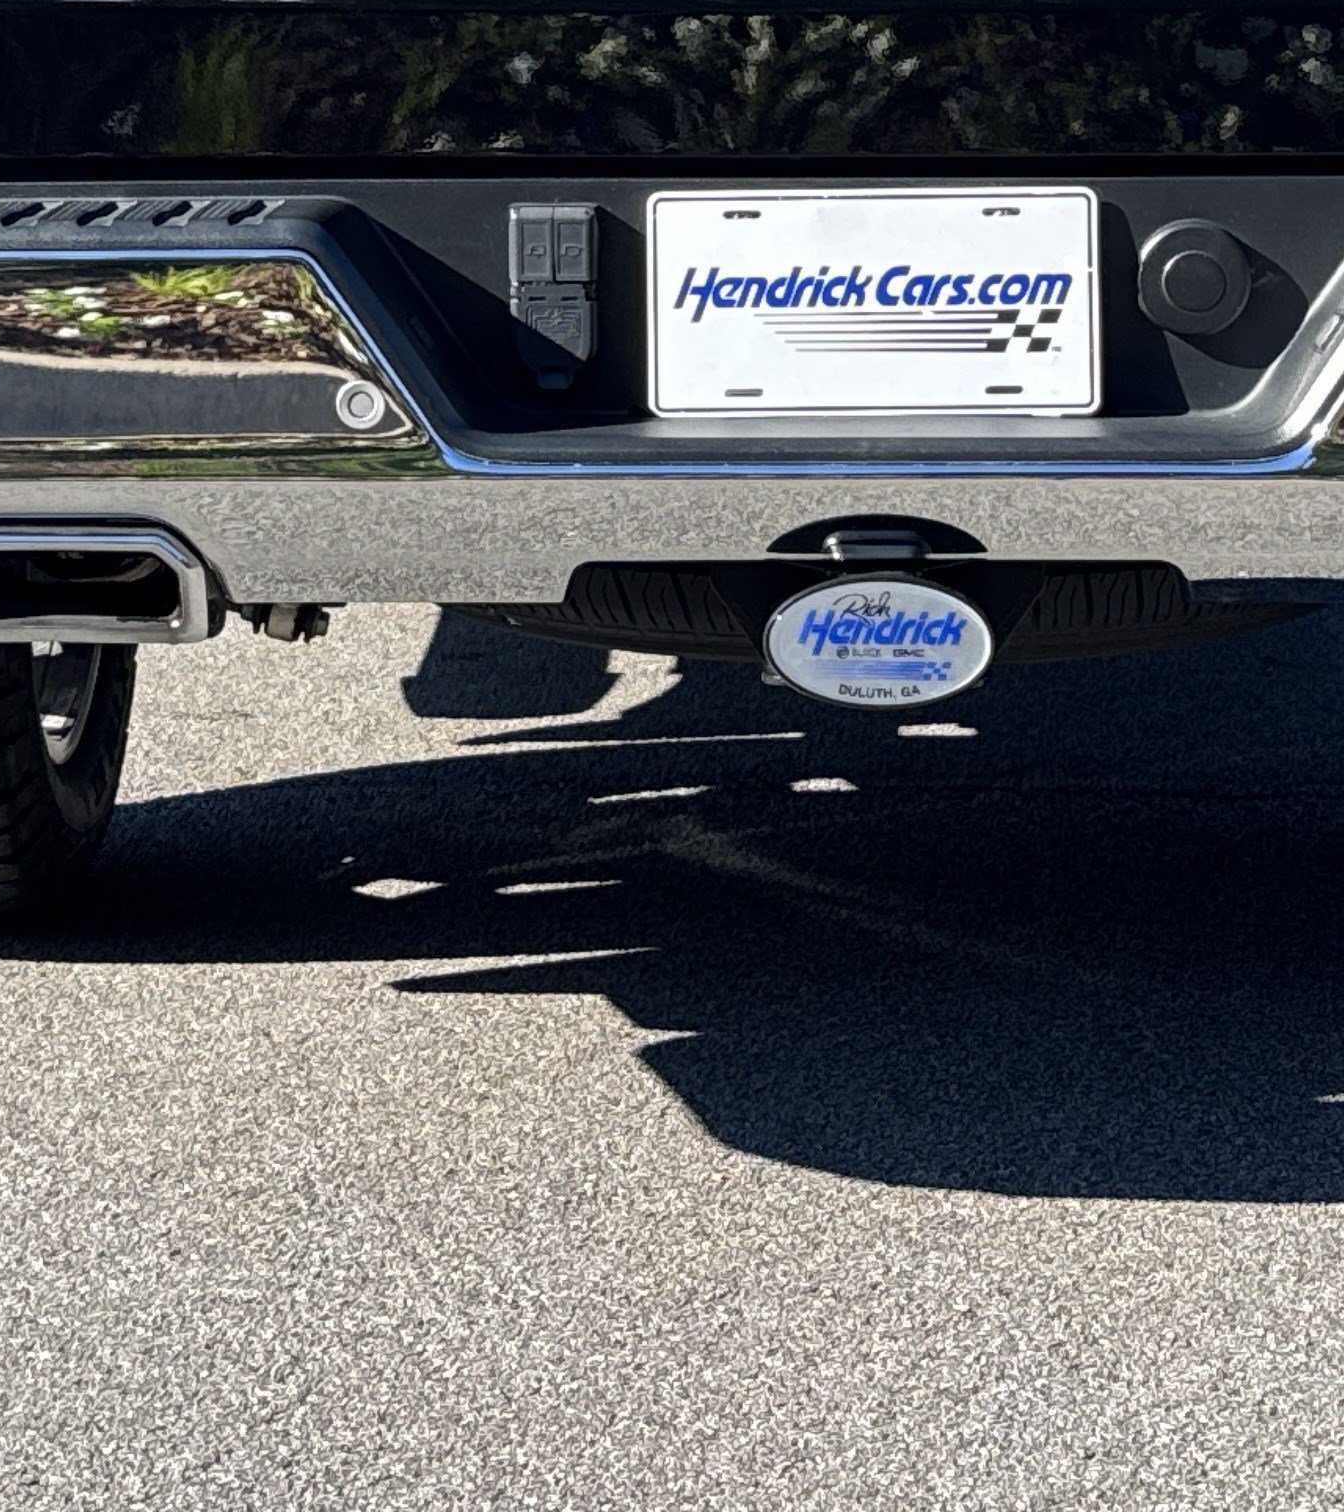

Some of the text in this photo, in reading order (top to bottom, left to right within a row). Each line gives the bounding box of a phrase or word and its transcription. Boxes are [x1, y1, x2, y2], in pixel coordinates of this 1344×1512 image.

[832, 591, 891, 623] Rich
[798, 609, 968, 657] Hendrick
[900, 684, 921, 697] GA
